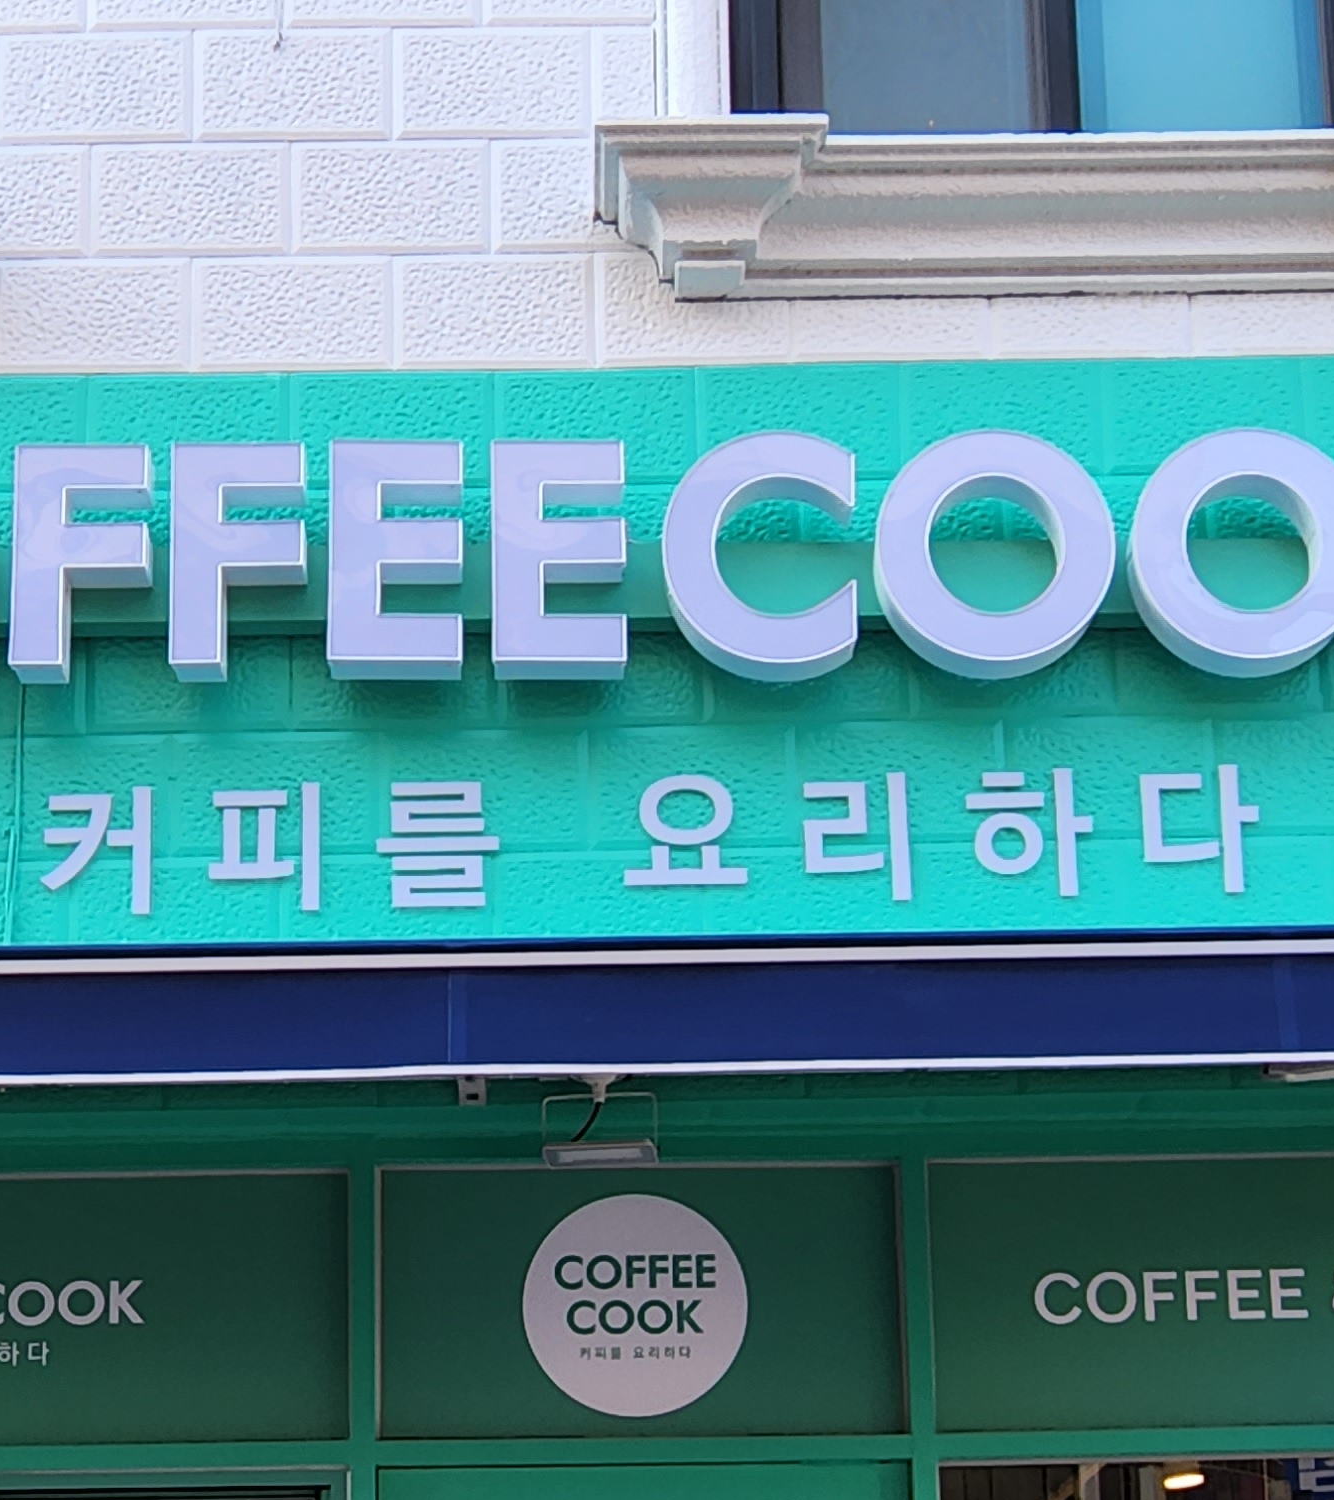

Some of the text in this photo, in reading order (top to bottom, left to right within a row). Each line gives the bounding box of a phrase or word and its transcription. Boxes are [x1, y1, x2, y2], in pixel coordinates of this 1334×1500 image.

[39, 759, 1263, 917] 커피를 요리하다
[554, 1254, 717, 1290] COFFEE
[566, 1299, 704, 1336] COOK
[1034, 1268, 1310, 1325] COFFEE
